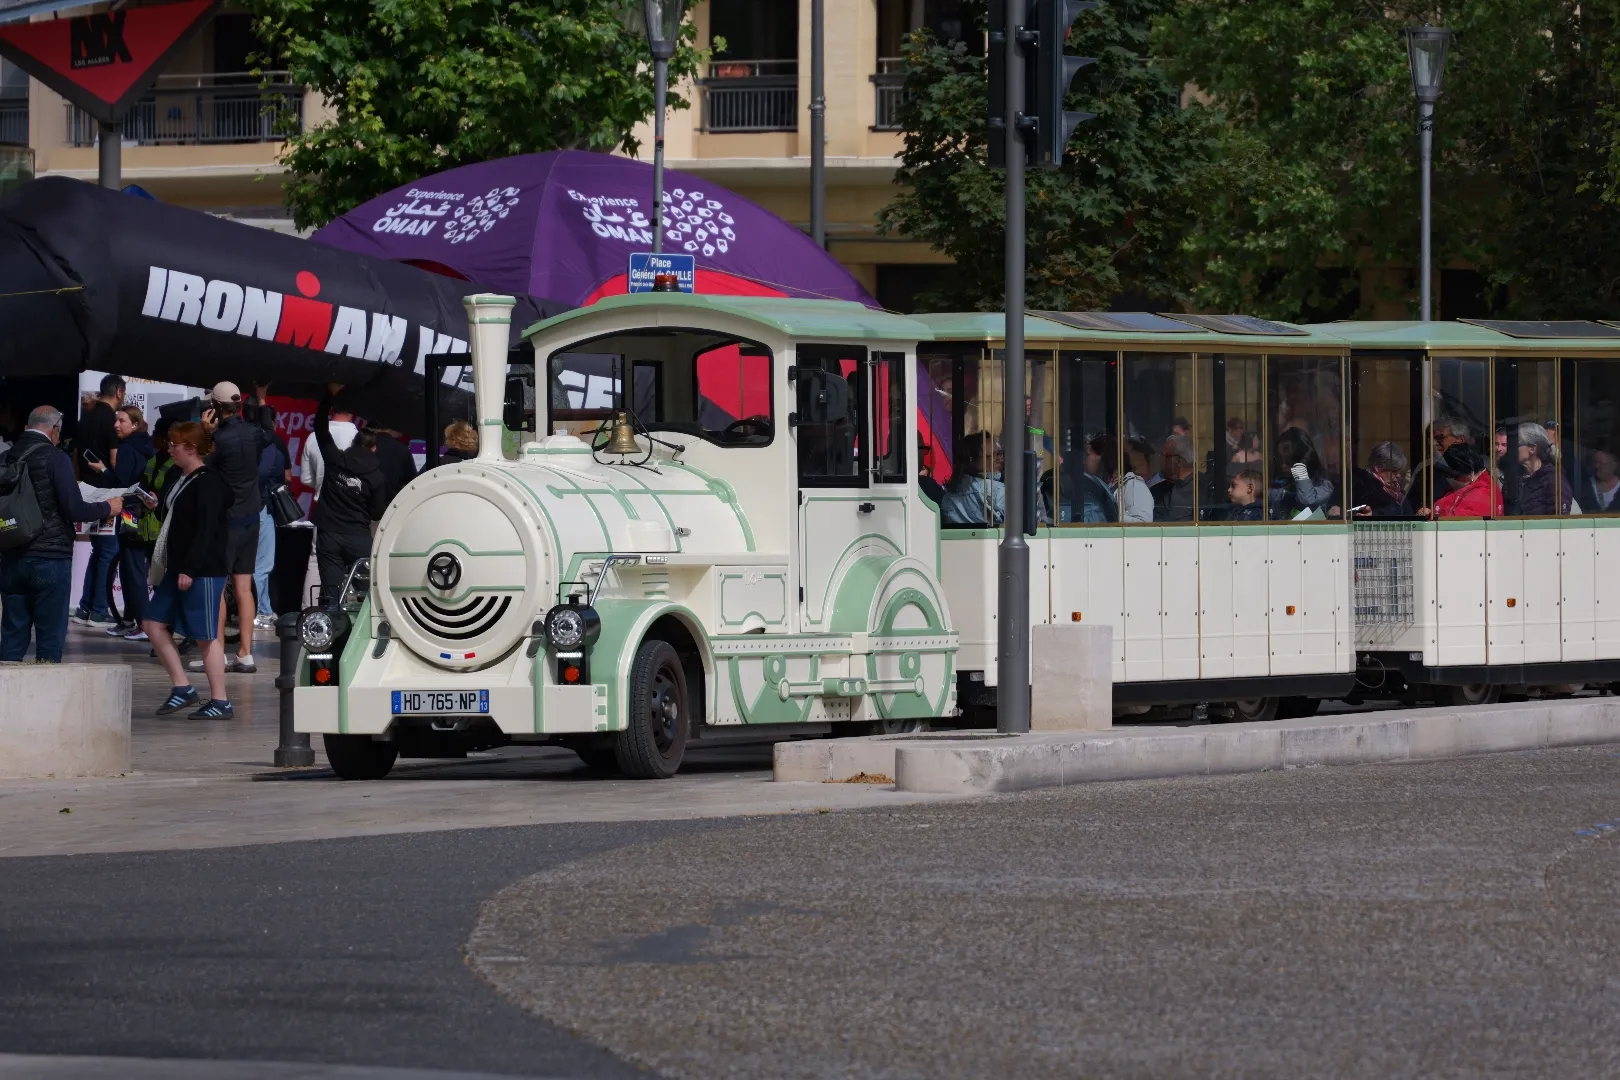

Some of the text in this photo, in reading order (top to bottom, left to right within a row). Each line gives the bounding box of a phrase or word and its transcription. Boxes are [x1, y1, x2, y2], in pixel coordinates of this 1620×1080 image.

[405, 188, 465, 201] Experience
[372, 216, 438, 236] OMAN
[651, 258, 671, 267] Place
[632, 269, 655, 279] Général
[142, 265, 622, 409] IRONMAN VIGE
[480, 702, 488, 711] 13
